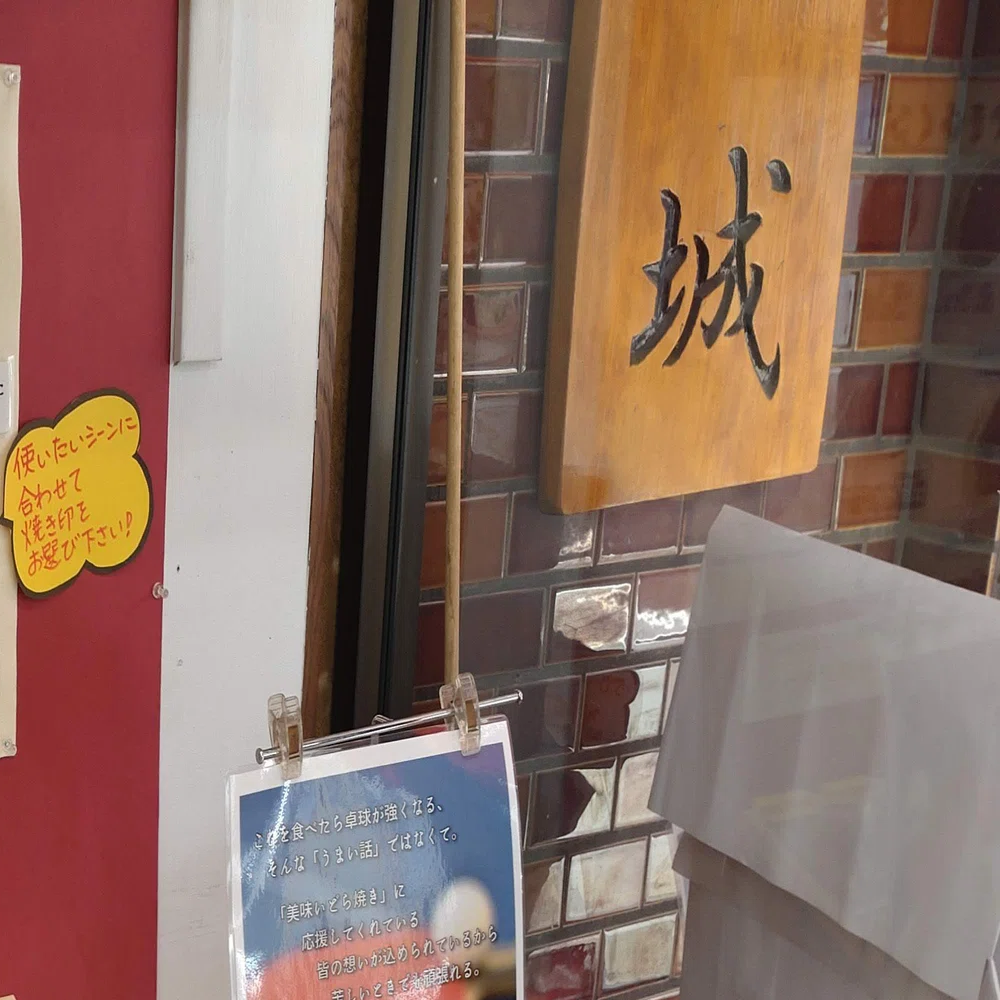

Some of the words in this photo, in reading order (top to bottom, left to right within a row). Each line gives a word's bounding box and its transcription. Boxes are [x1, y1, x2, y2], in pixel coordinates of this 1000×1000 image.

[629, 146, 793, 401] 城
[12, 416, 138, 481] 使いたいシーンに
[17, 467, 83, 517] 合わせて
[20, 500, 91, 553] 焼き印を
[300, 910, 421, 952] 応援してくれている
